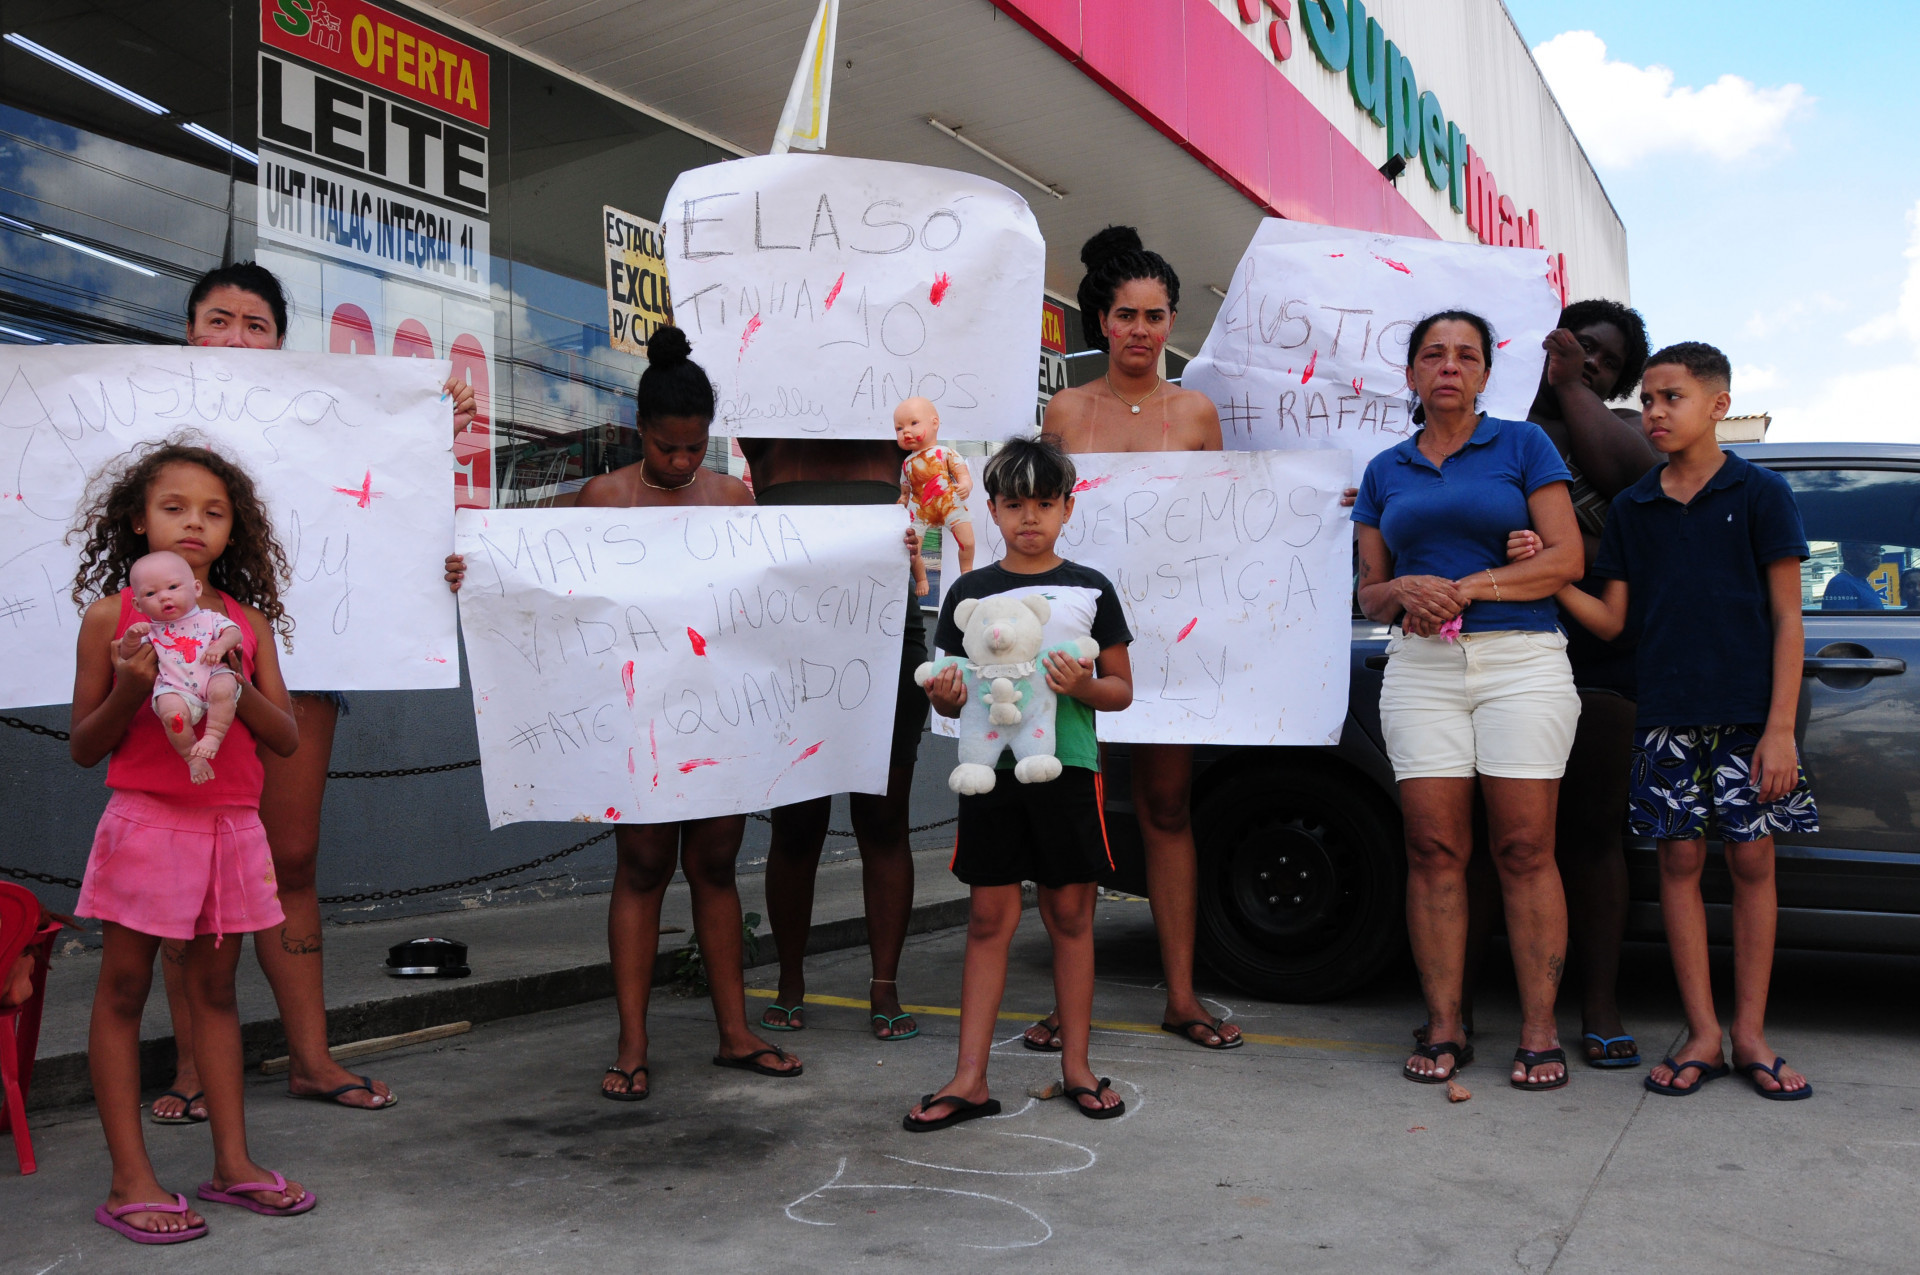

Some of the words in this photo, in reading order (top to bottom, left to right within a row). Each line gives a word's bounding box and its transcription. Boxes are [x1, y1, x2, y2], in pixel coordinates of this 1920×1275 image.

[351, 14, 478, 111] OFERTA
[261, 56, 487, 208] LEITE
[266, 162, 306, 235] UHT
[310, 176, 373, 254] ITALAC
[377, 196, 457, 277] INTEGRAL
[460, 224, 478, 284] 1L
[851, 366, 980, 410] ANOS
[684, 513, 812, 564] UMA
[663, 658, 872, 735] QUANDO
